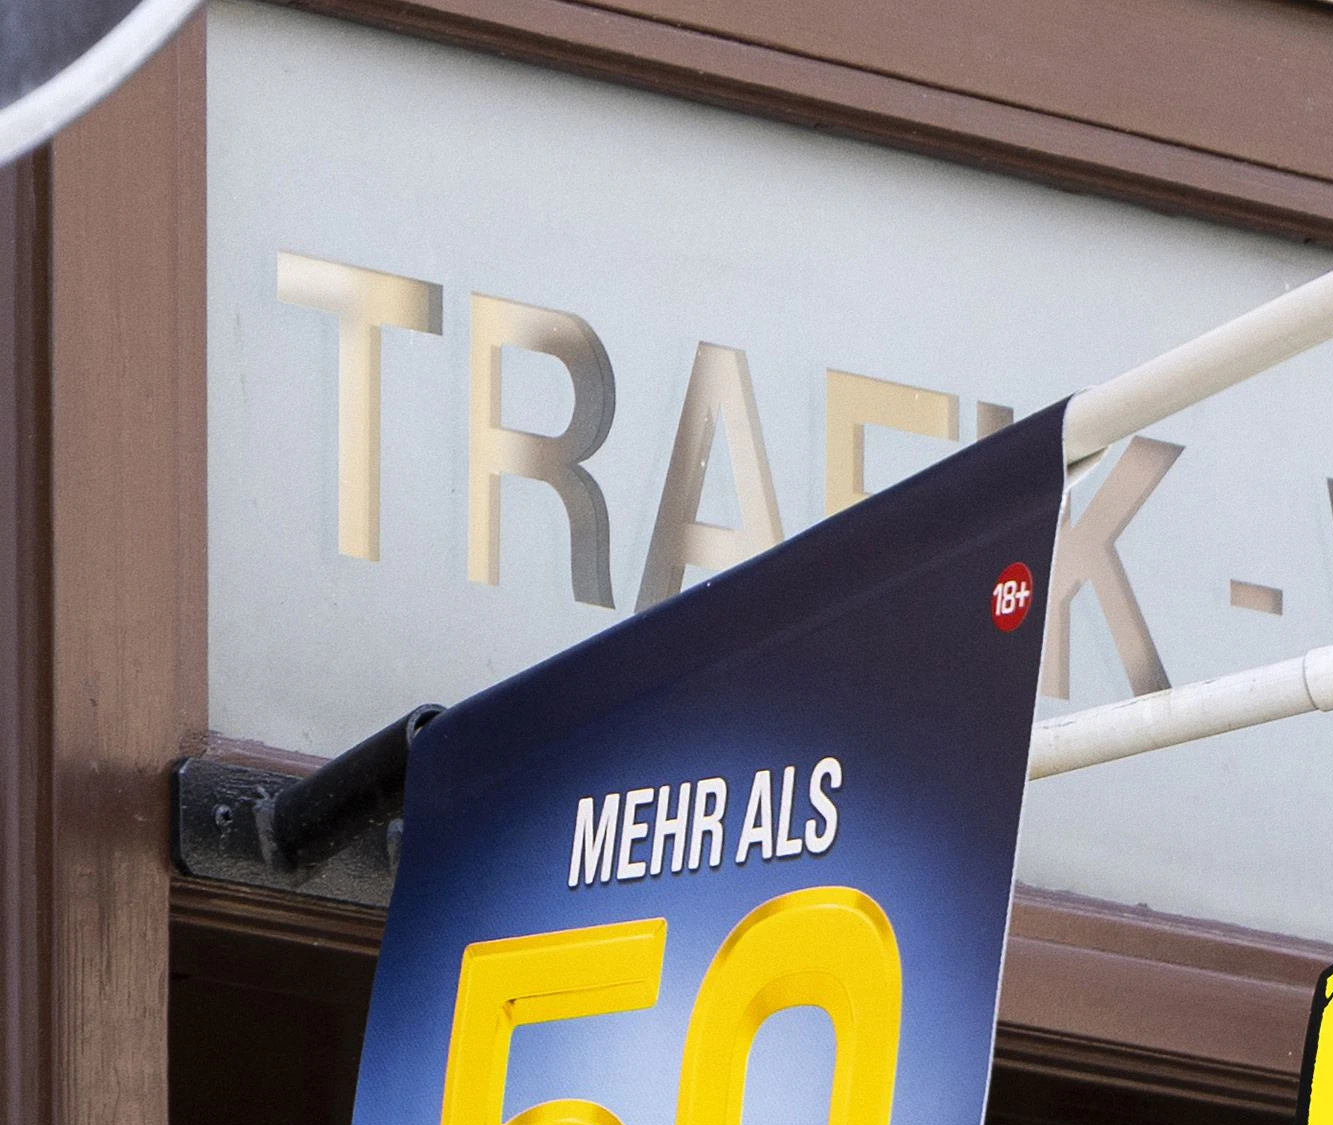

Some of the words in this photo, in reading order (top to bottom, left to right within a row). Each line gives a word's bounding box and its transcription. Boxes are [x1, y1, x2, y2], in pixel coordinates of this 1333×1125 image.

[276, 250, 1186, 700] TRAFK
[991, 578, 1033, 618] 18+
[568, 776, 727, 888] MEHR
[736, 756, 844, 864] ALS
